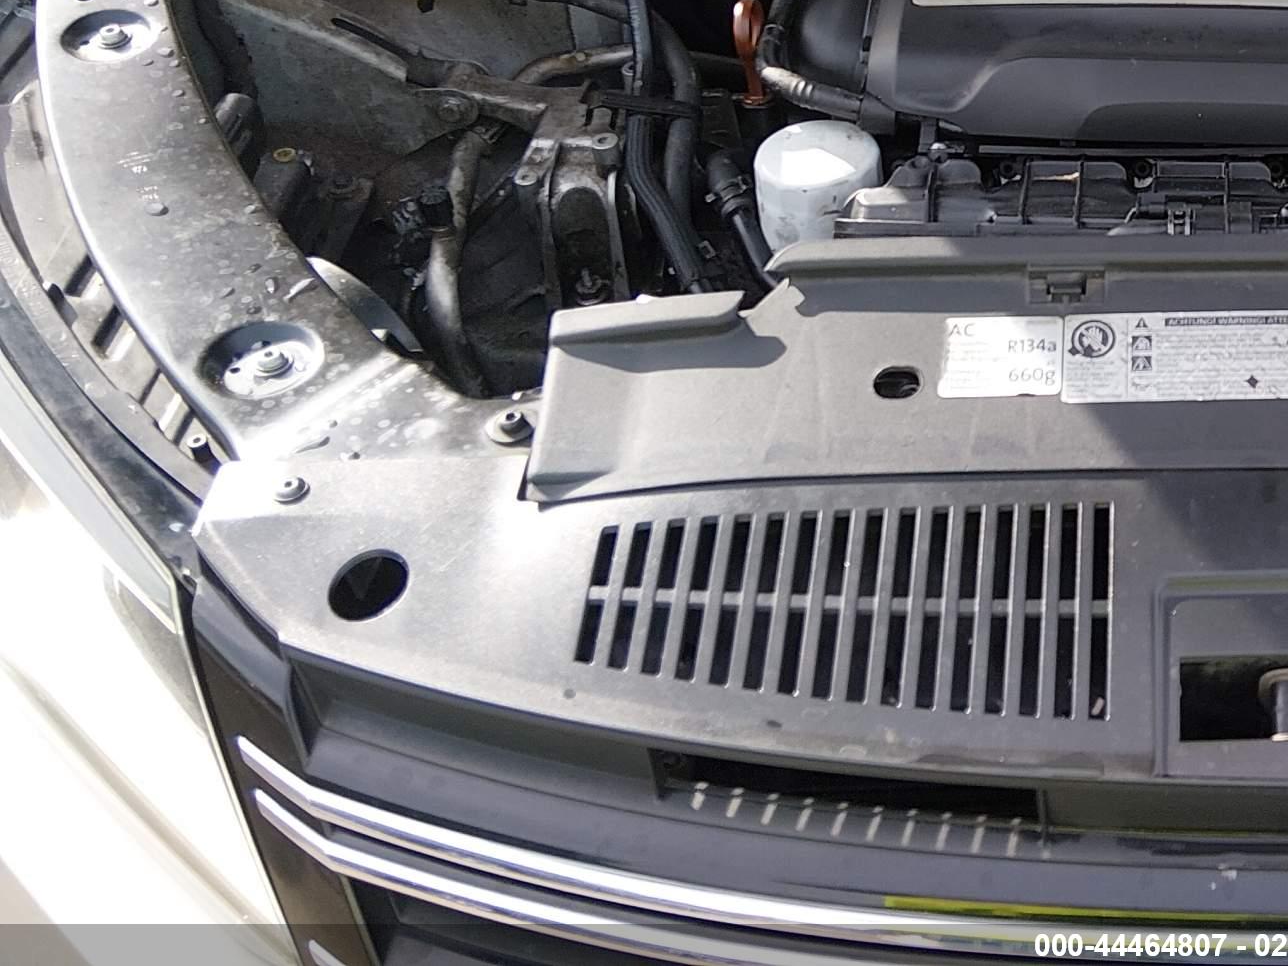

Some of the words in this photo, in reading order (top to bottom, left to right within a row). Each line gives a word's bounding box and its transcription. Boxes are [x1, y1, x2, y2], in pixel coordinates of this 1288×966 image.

[1169, 317, 1216, 326] ACHTUNG!
[948, 323, 976, 337] AC
[1008, 338, 1057, 353] R134a
[1008, 368, 1056, 386] 660g
